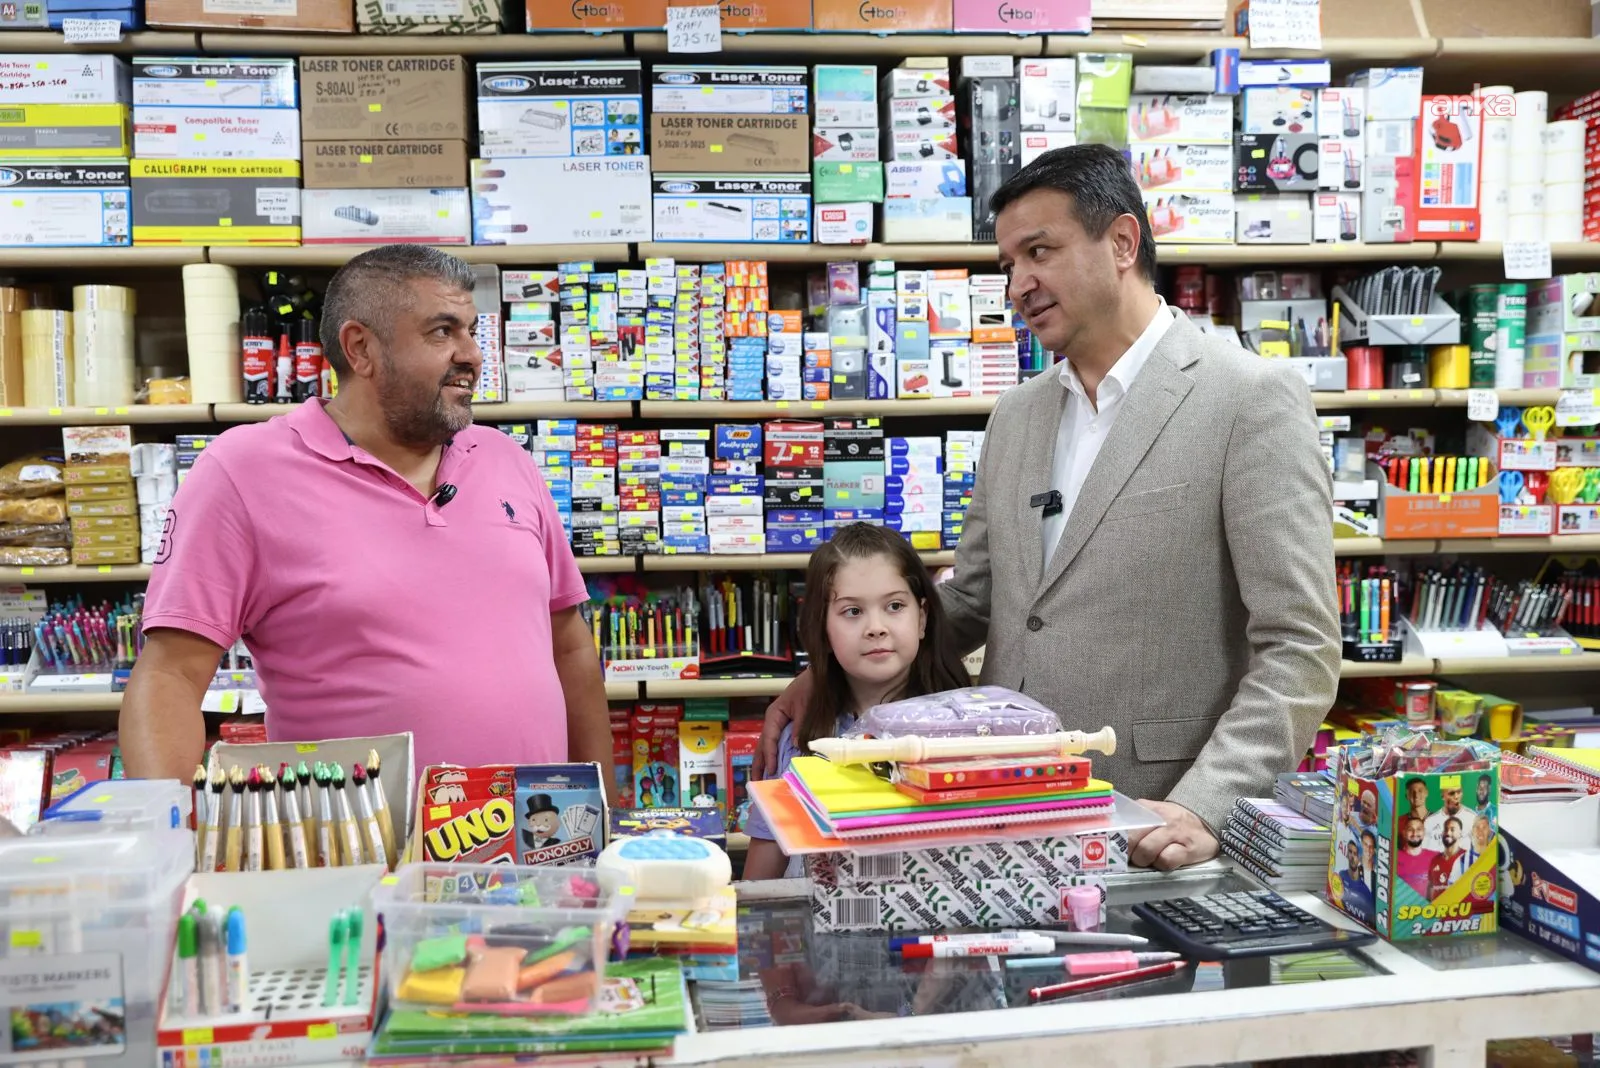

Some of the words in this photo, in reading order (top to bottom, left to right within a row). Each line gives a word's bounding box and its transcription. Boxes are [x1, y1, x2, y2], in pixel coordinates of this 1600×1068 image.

[3, 4, 15, 16] A4
[192, 64, 235, 75] Laser
[240, 64, 282, 75] Toner
[302, 60, 338, 72] LASER
[342, 60, 383, 72] TONER
[387, 59, 455, 71] CARTRIDGE
[540, 76, 578, 86] Laser
[582, 75, 624, 86] Toner
[711, 73, 754, 82] Laser
[759, 73, 802, 82] Toner
[316, 81, 355, 96] S-80AU
[1184, 108, 1228, 116] Organizer
[184, 116, 232, 125] Compatible
[661, 118, 694, 128] LASER
[696, 118, 734, 128] TONER
[737, 118, 797, 129] CARTRIDGE
[221, 126, 258, 134] Cartridge
[316, 145, 346, 156] LASER
[350, 145, 383, 155] TONER
[386, 144, 443, 154] CARTRIDGE
[563, 162, 600, 172] LASER
[605, 161, 644, 170] TONER
[1186, 158, 1228, 166] Organizer
[144, 164, 207, 174] CALLIGRAPH
[27, 170, 72, 180] Laser
[76, 170, 125, 179] Toner
[715, 182, 755, 190] Laser
[759, 182, 802, 190] Toner
[426, 798, 514, 860] UNO
[527, 839, 590, 864] MONOPOLY
[1378, 836, 1390, 904] DEVRE
[900, 891, 917, 911] Bond
[996, 888, 1016, 908] Bond
[1397, 903, 1473, 921] SPORCU
[1378, 910, 1388, 929] 2.
[1412, 922, 1426, 934] 2.
[1431, 919, 1481, 933] DEVRE
[968, 946, 1009, 954] SNOWMAN
[44, 968, 111, 983] MARKERS
